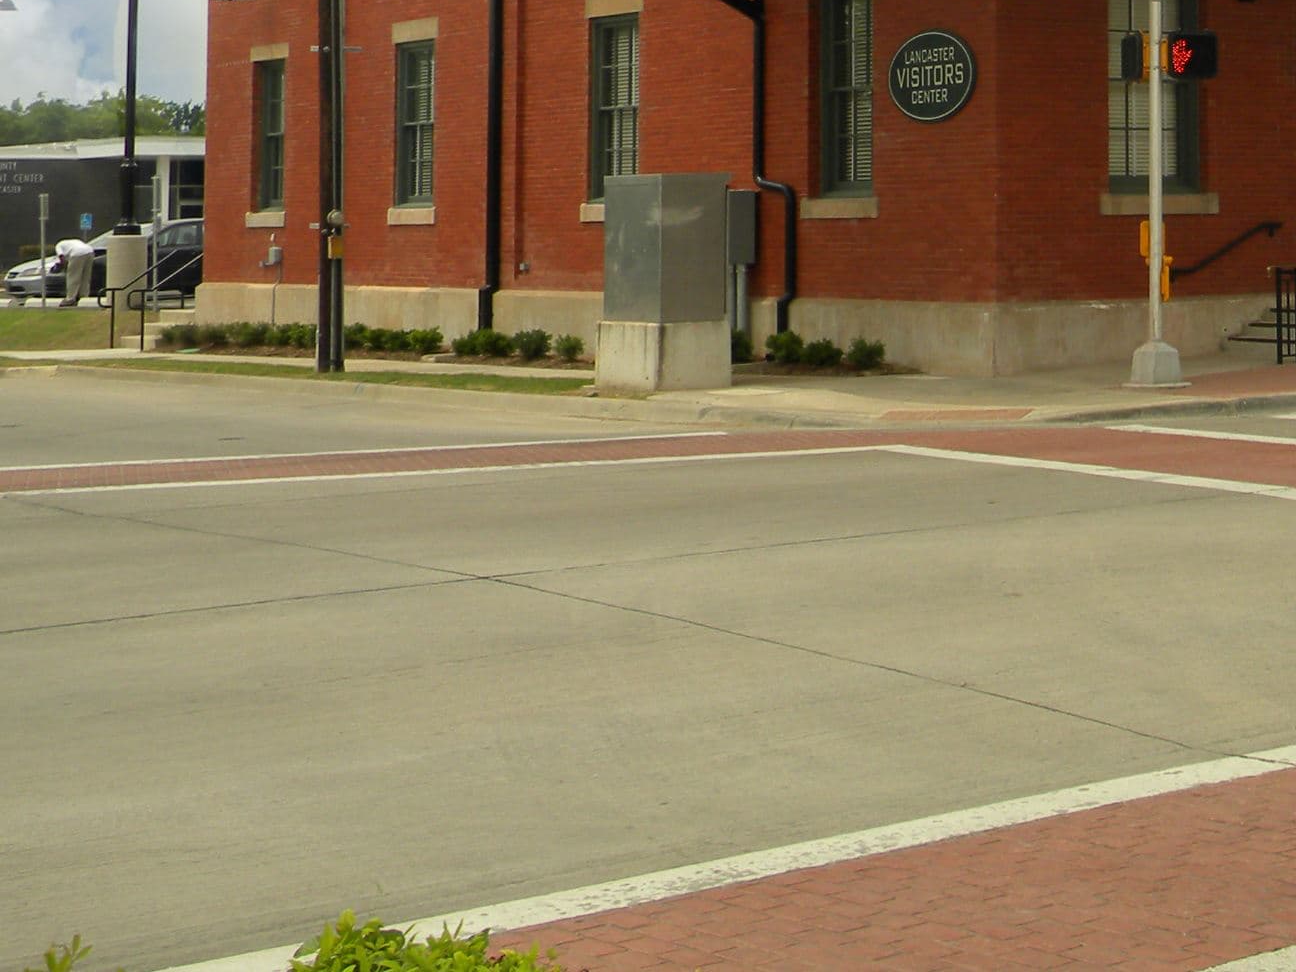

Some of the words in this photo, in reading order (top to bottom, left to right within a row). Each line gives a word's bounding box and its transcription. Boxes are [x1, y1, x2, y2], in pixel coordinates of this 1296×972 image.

[904, 46, 955, 65] LANCASTER
[896, 63, 964, 89] VISITORS
[911, 88, 948, 105] CENTER
